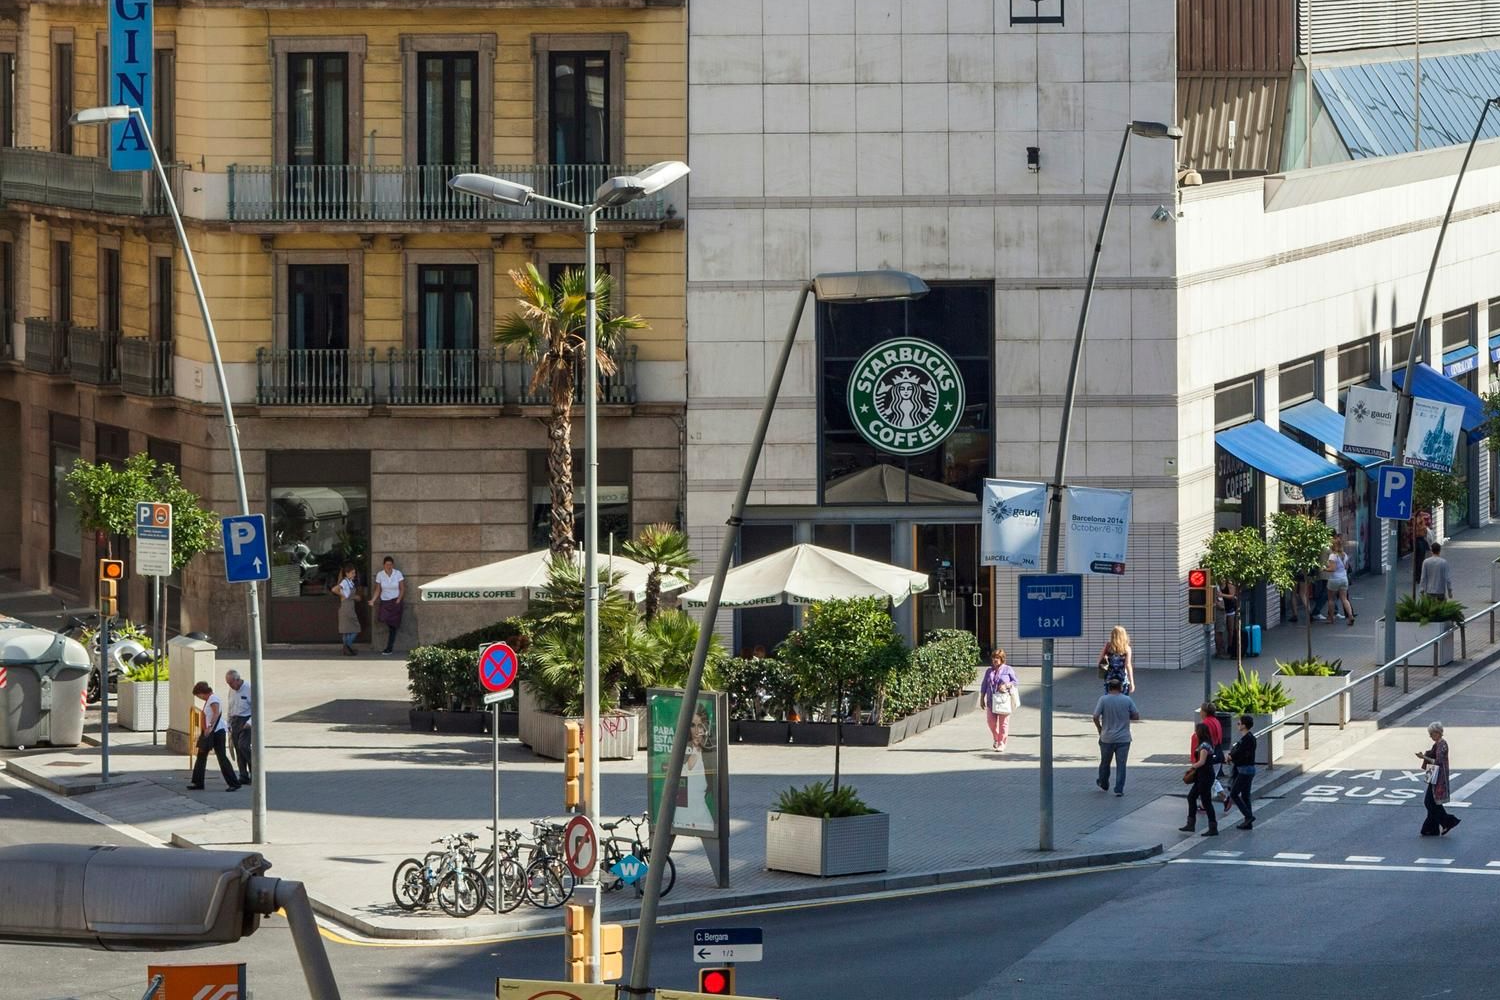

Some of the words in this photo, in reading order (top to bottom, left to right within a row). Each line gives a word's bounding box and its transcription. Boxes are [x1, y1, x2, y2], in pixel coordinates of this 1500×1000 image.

[856, 347, 955, 393] STARBUCKS
[1370, 410, 1393, 420] gaudi
[869, 420, 944, 447] COFFEE
[1384, 470, 1406, 498] P
[140, 506, 150, 522] P
[1012, 507, 1040, 517] gaudi
[1072, 514, 1106, 523] Barcelona
[1107, 516, 1124, 524] 2014
[230, 521, 256, 556] P
[426, 590, 481, 600] STARBUCKS
[482, 590, 516, 598] COFFEE
[1038, 616, 1065, 628] taxi
[1300, 785, 1425, 799] BUS
[620, 862, 640, 876] W
[696, 933, 703, 942] C.
[704, 932, 728, 944] Bergara
